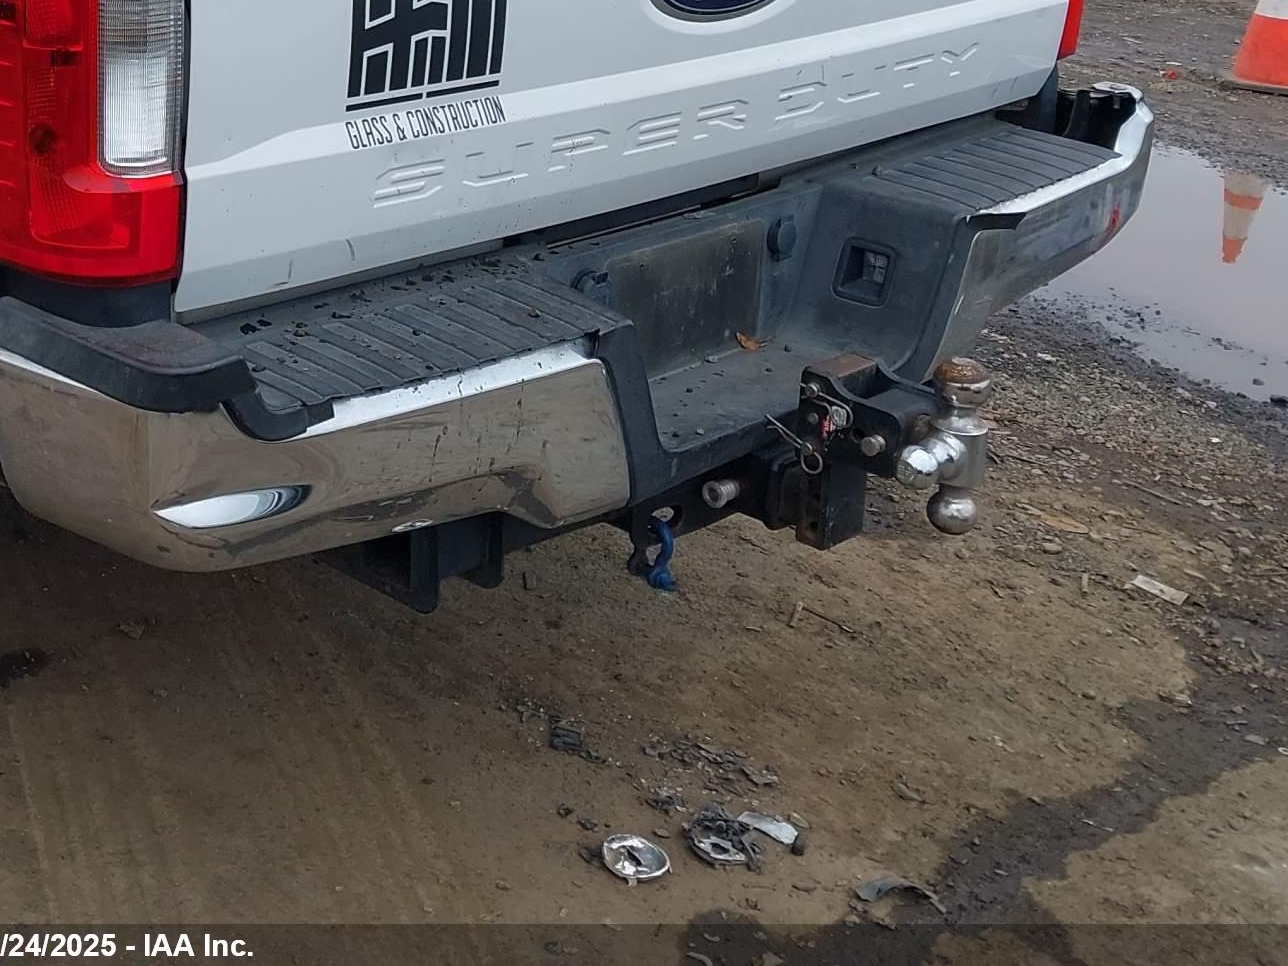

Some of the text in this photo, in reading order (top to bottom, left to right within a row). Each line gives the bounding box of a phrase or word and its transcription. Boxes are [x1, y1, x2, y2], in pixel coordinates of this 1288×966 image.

[345, 96, 507, 150] GLASS & CONSTRUCTION
[370, 41, 980, 209] SUPER DUTY
